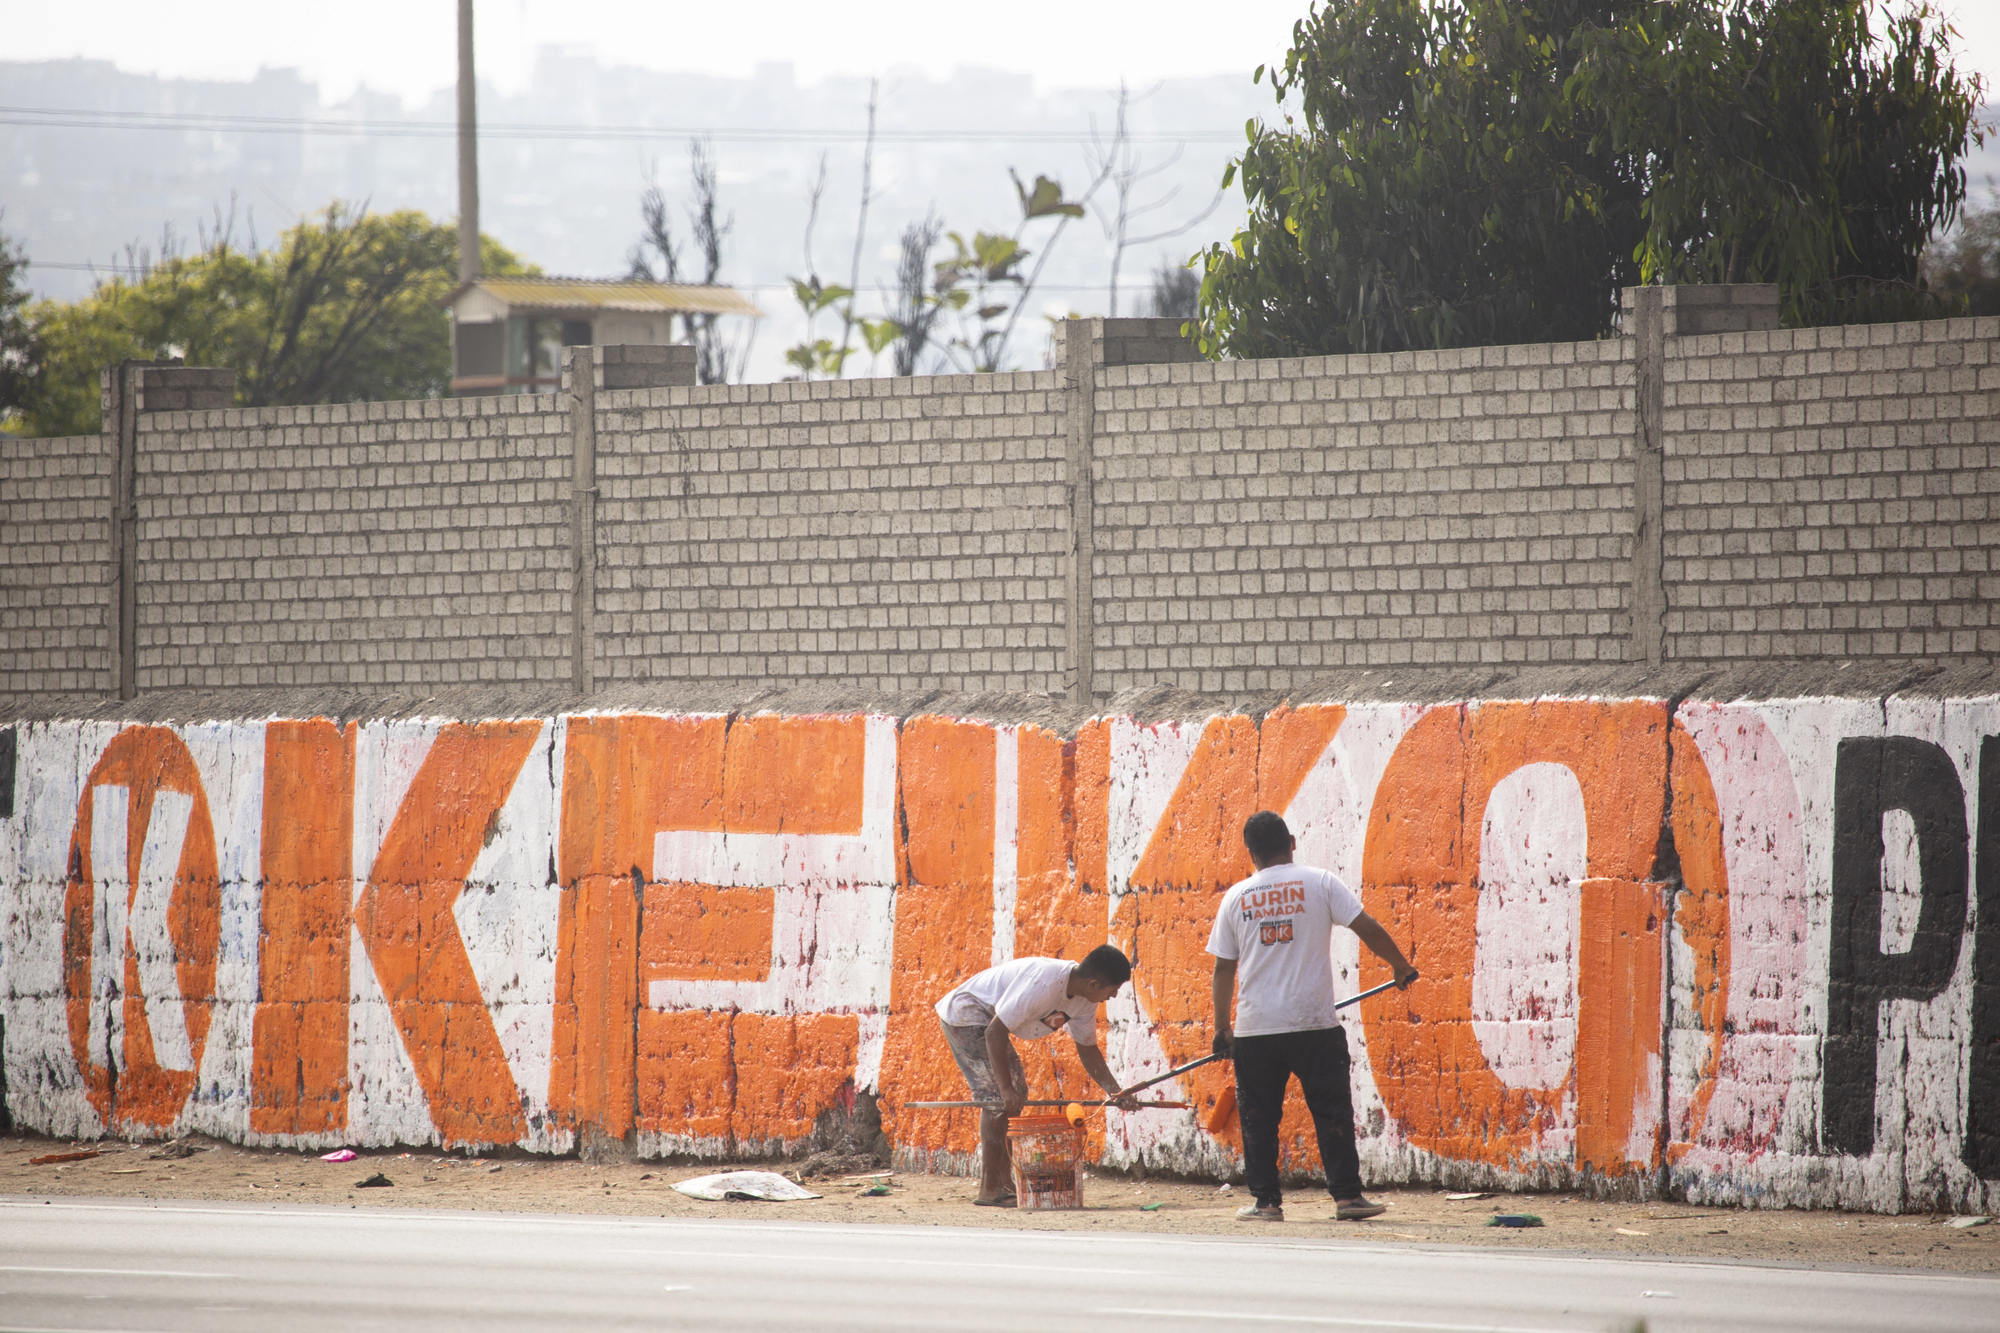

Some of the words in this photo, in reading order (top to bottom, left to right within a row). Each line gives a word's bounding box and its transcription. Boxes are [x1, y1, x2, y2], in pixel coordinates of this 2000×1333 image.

[1273, 880, 1304, 889] SIEMPRE
[1241, 887, 1306, 911] LURÍN
[1243, 904, 1306, 922] HAMADA
[91, 783, 194, 1074] K
[250, 699, 1730, 1176] KEIKO
[1824, 734, 2000, 1181] P
[1262, 929, 1273, 941] K
[1279, 926, 1290, 939] K
